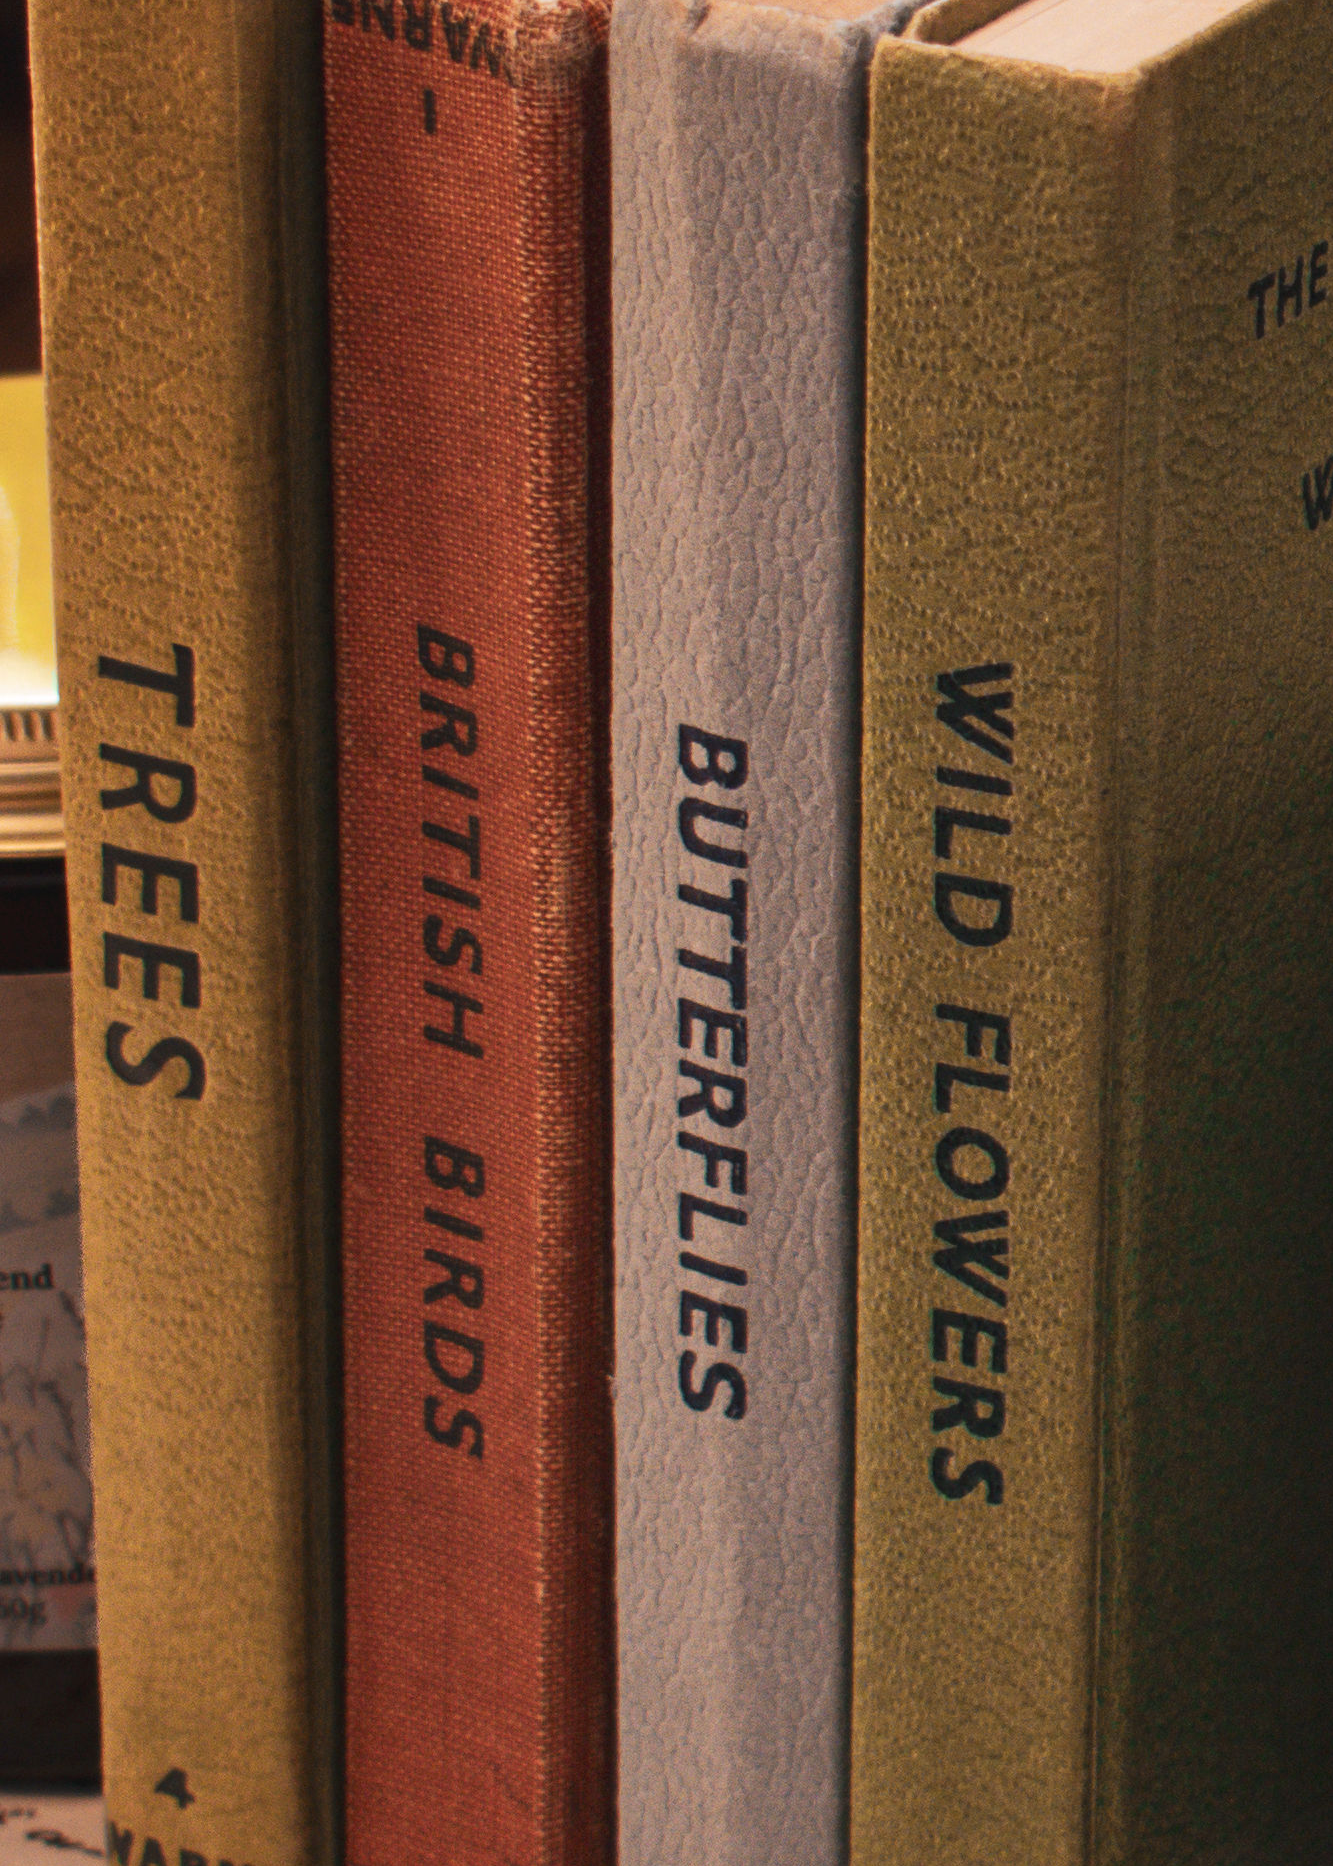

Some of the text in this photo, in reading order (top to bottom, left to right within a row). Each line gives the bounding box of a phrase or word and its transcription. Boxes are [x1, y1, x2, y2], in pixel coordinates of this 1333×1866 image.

[1248, 240, 1329, 339] THE
[97, 643, 207, 1102] TREES
[416, 623, 486, 1460] BRITISH BIRDS
[677, 723, 749, 1422] BUTTERFLIES
[931, 661, 1014, 1507] WILD FLOWERS
[154, 1768, 195, 1810] 4
